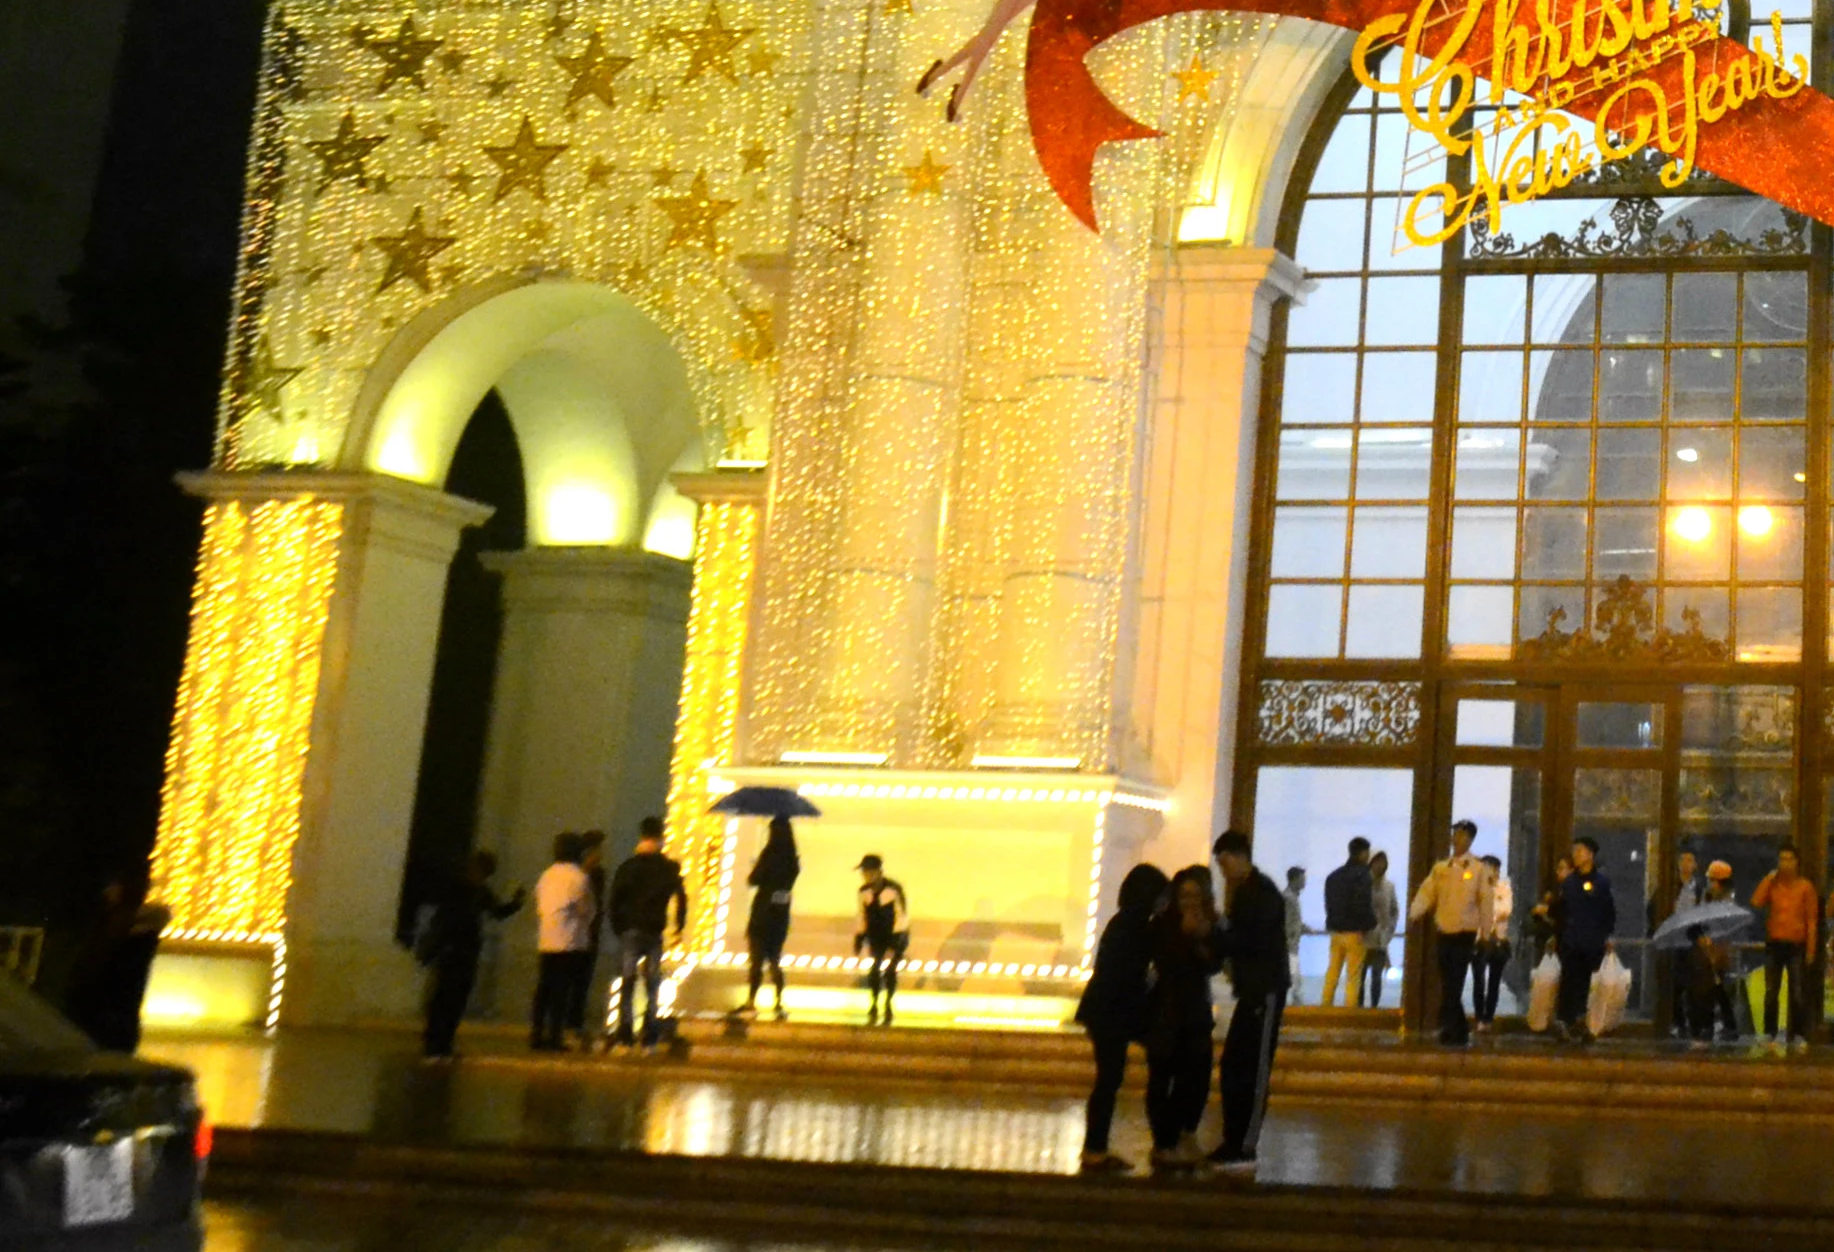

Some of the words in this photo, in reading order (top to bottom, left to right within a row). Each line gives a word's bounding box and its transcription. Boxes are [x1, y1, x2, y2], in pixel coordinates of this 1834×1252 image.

[1404, 112, 1594, 247] New
[1594, 9, 1808, 189] Year!
[1493, 80, 1575, 135] AND
[1592, 10, 1724, 90] HAPPY
